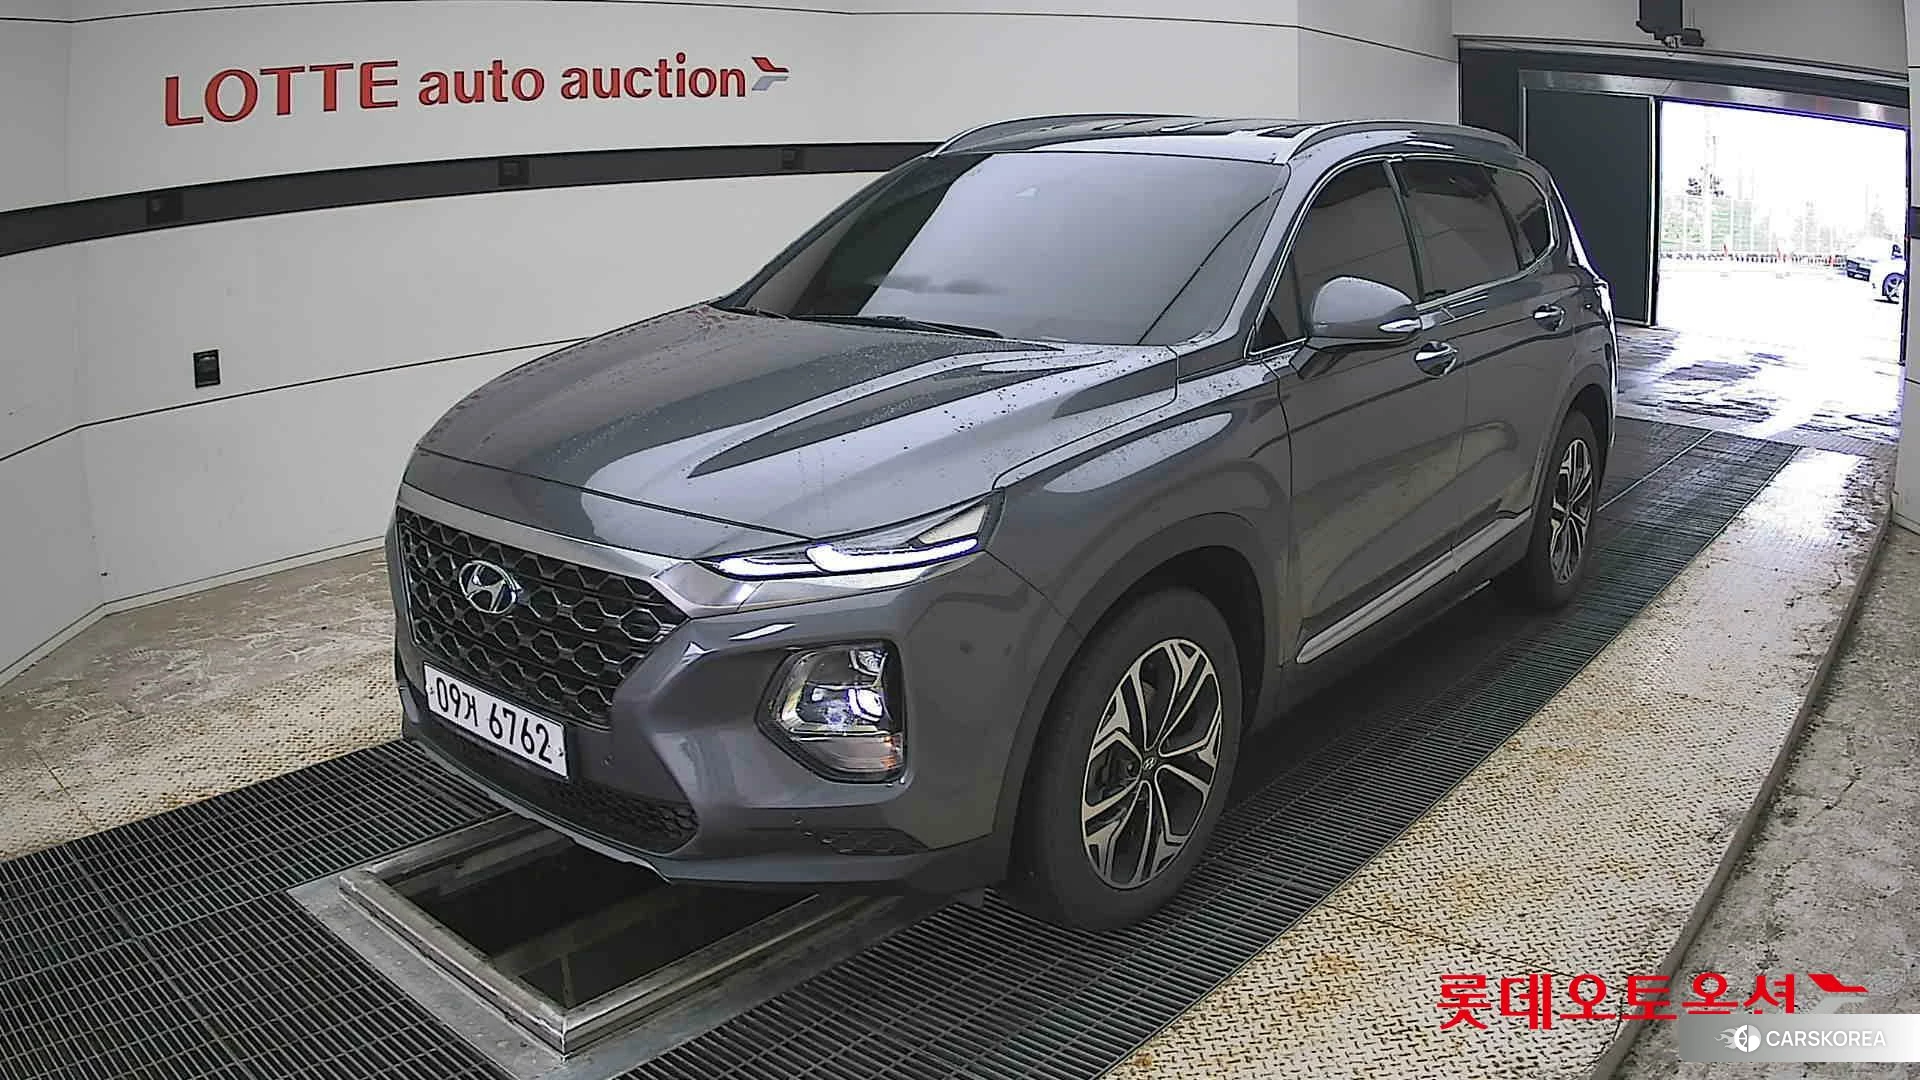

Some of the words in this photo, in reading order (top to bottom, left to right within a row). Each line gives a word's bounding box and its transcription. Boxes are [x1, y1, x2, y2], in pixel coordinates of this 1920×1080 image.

[163, 60, 398, 127] LOTTE
[418, 59, 545, 106] auto
[560, 52, 747, 99] auction
[436, 677, 478, 727] 09거
[489, 703, 552, 764] 6762
